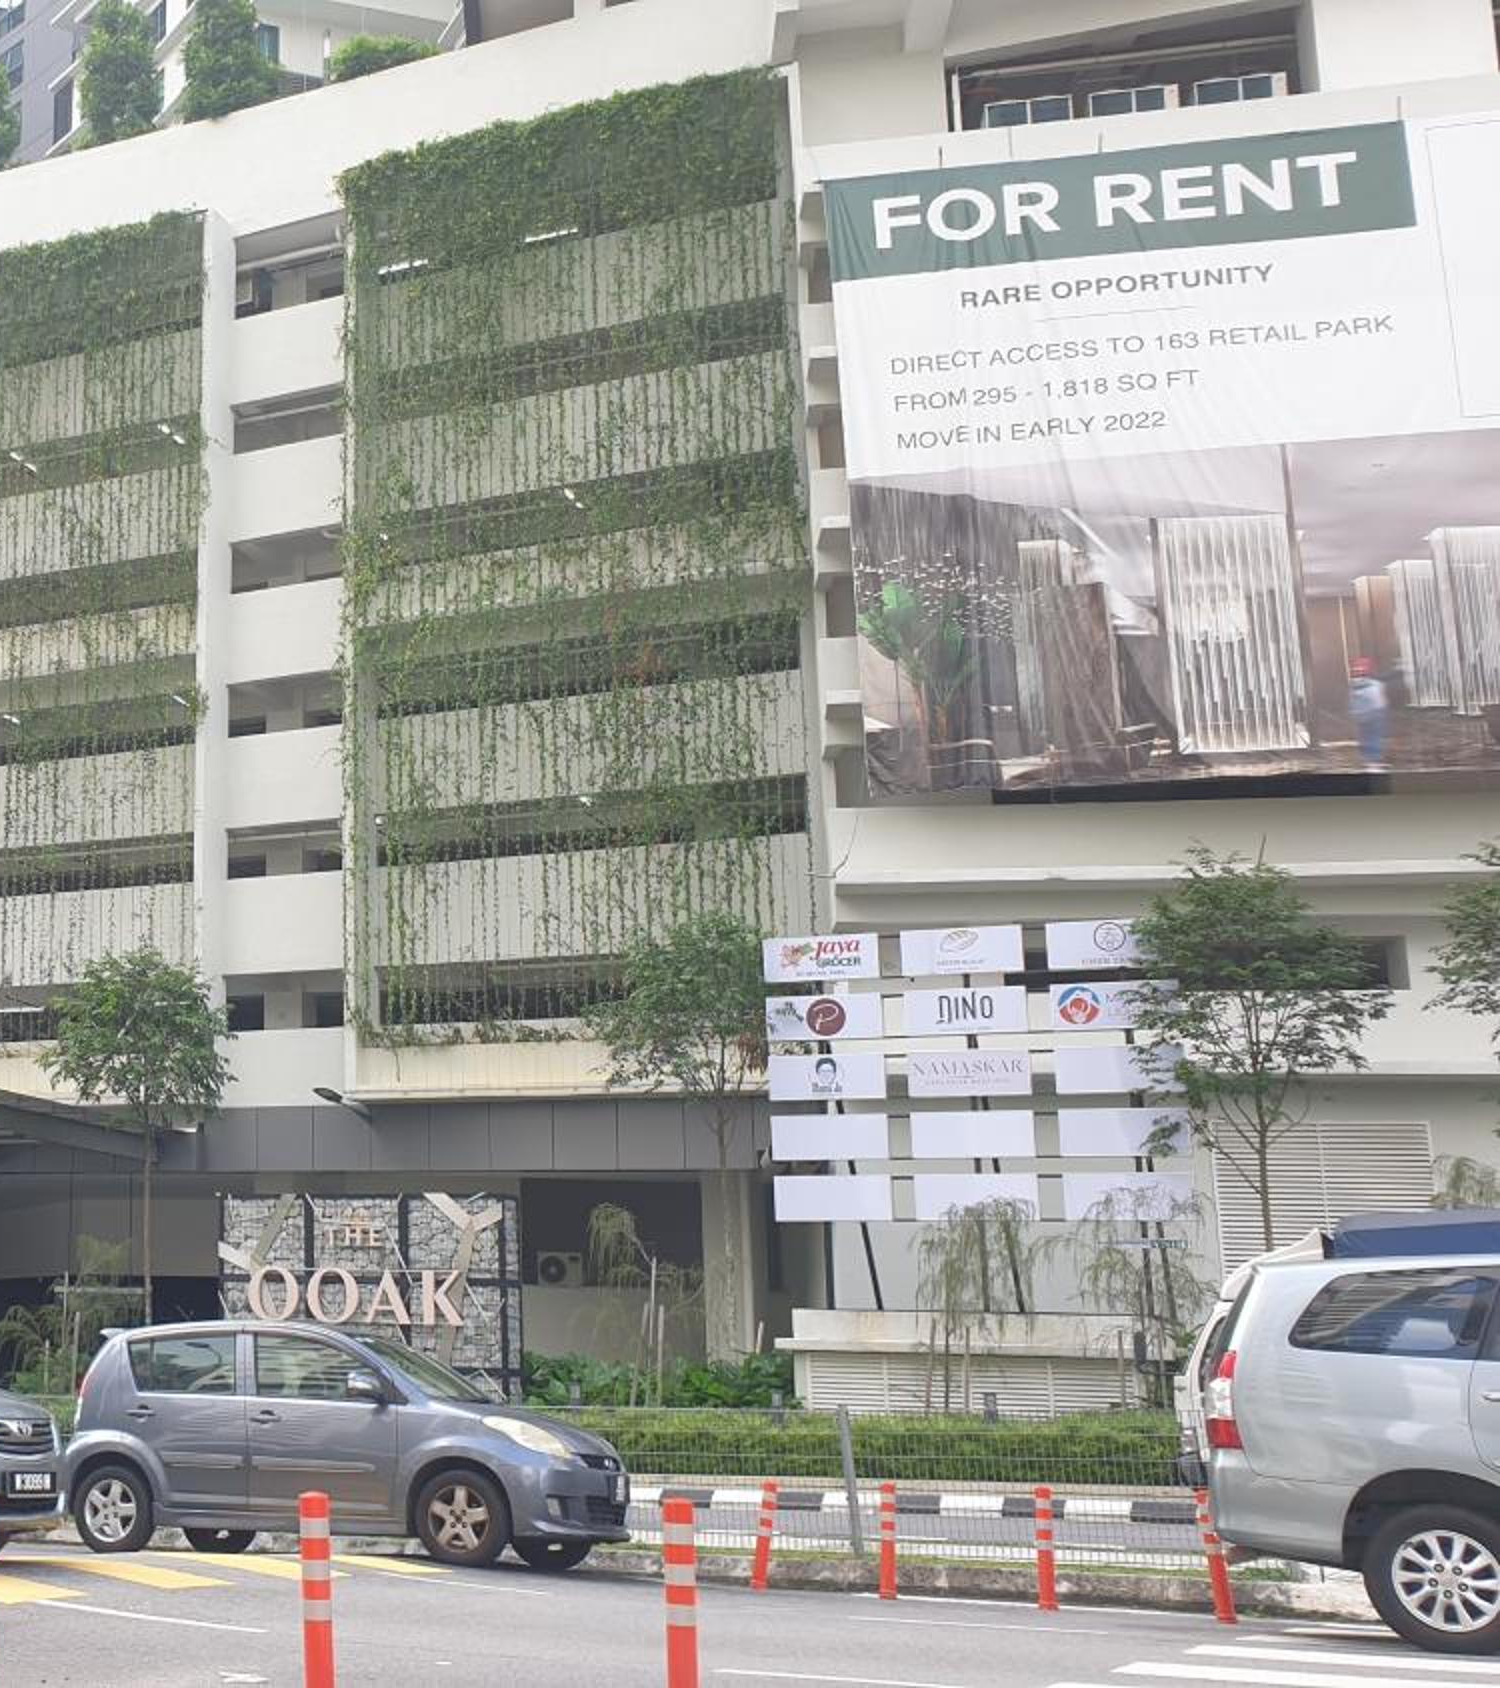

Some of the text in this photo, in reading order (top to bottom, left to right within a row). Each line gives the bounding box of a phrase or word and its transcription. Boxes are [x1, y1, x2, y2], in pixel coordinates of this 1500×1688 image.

[873, 151, 1357, 249] FOR RENT
[960, 263, 1274, 308] RARE OPPORTUNITY
[891, 315, 1395, 375] DIRECT ACCESS TO 163 RETAIL PARK
[894, 387, 967, 412] FROM
[973, 386, 1017, 406] 295
[1117, 372, 1157, 393] SQ
[1167, 369, 1199, 388] FT
[897, 411, 1167, 449] MOVE IN EARLY 2022
[936, 991, 993, 1024] DINO
[913, 1059, 1022, 1075] NAMASKAR
[326, 1228, 385, 1247] THE
[249, 1266, 465, 1327] OOAK
